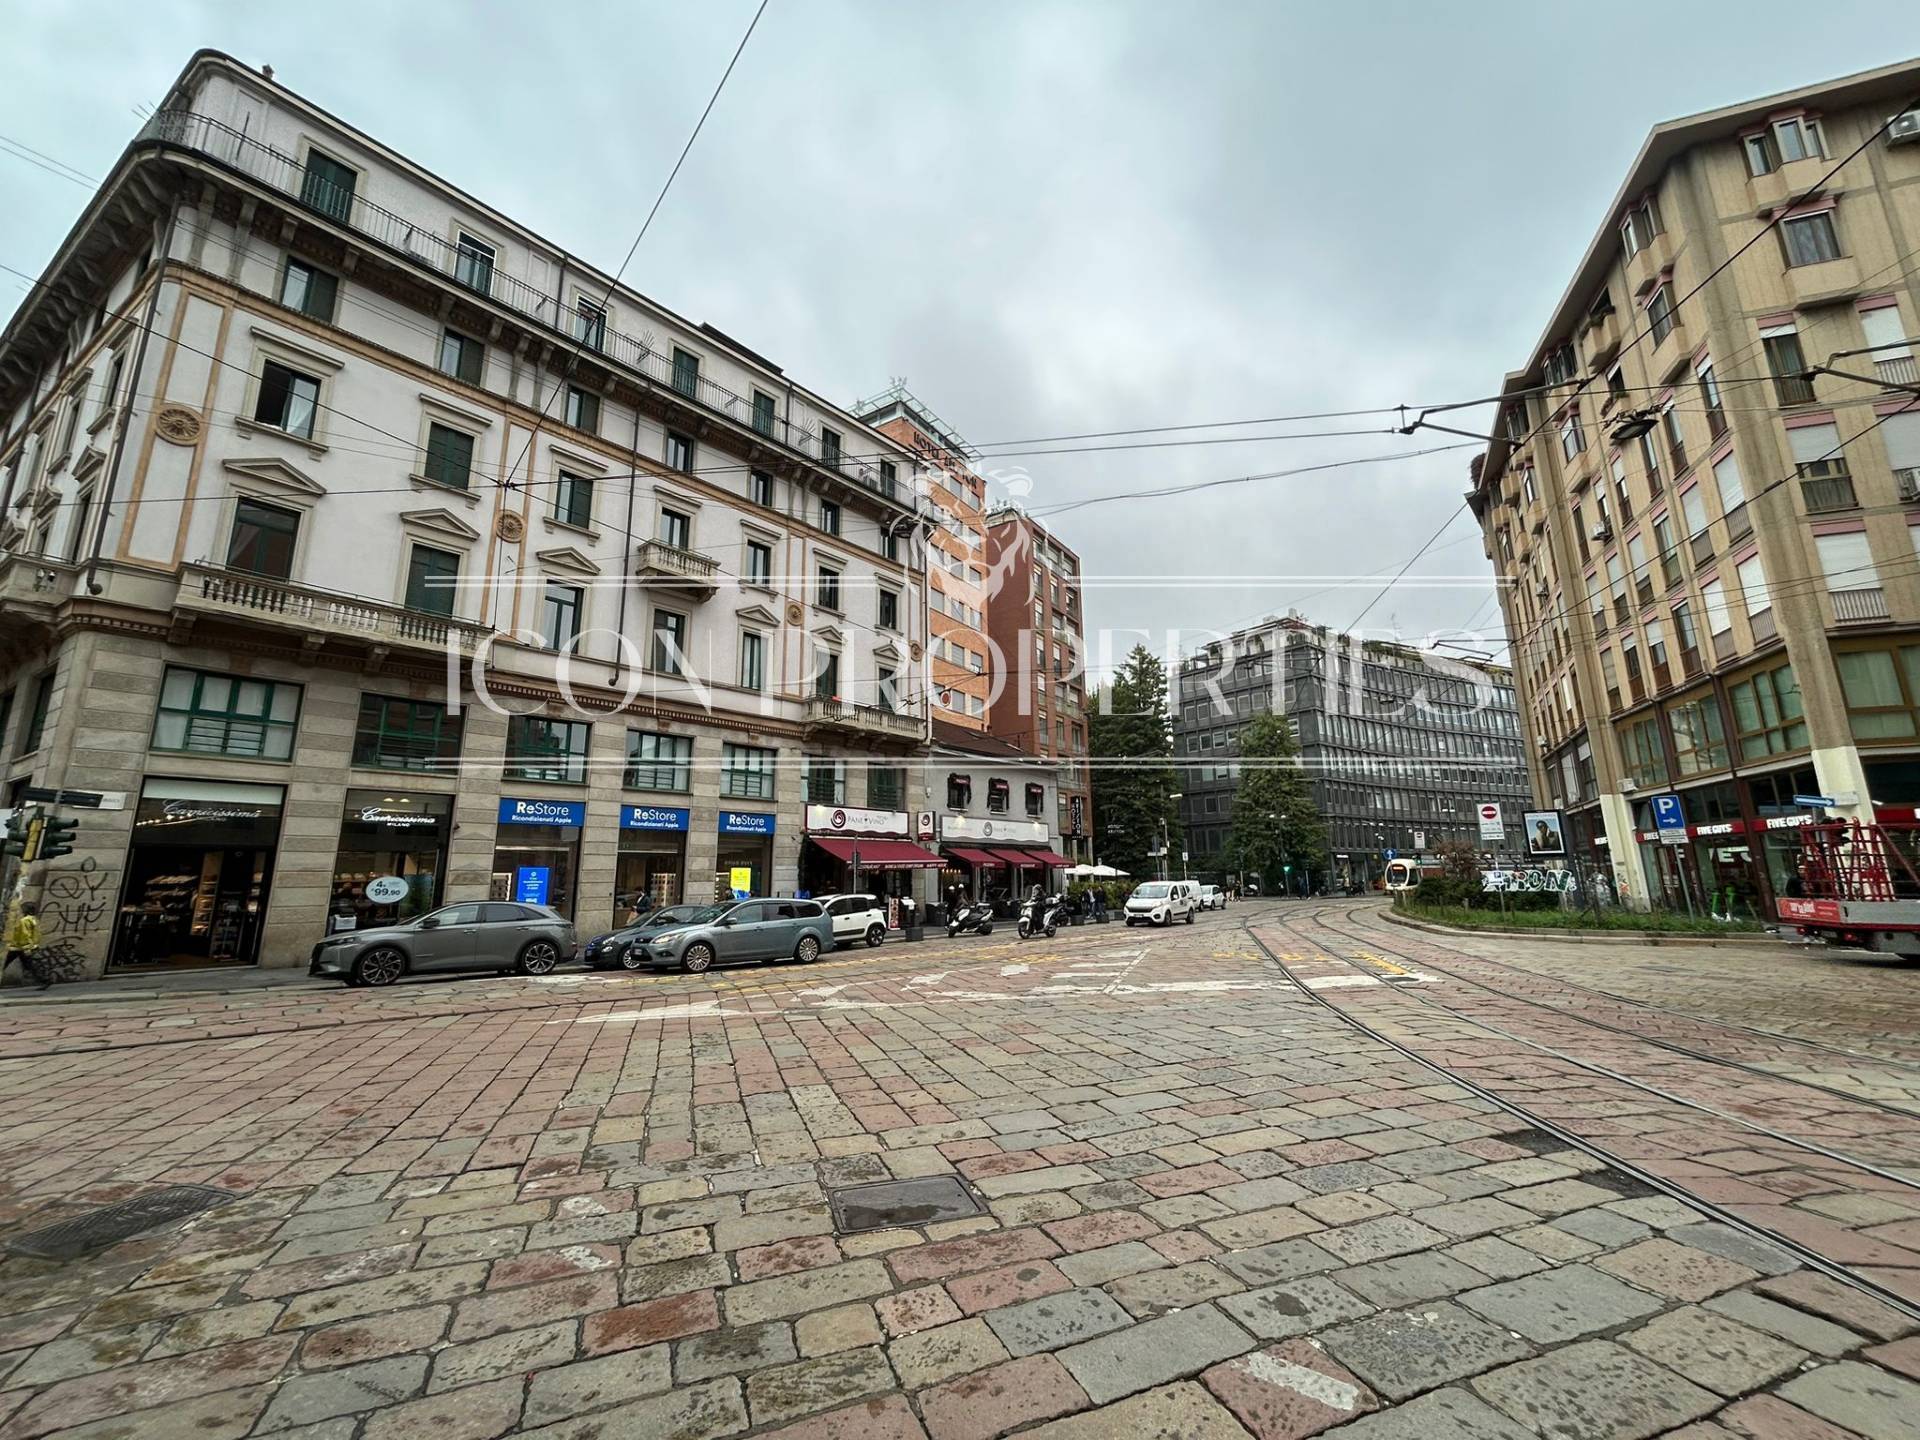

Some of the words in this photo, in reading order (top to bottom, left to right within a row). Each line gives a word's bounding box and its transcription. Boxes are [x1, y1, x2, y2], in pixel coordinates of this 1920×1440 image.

[913, 431, 940, 460] HOTEL
[516, 801, 569, 816] ReStore
[1657, 798, 1674, 815] P
[511, 814, 554, 824] Ricondizionati
[633, 808, 678, 822] ReStore
[729, 814, 765, 827] ReStore
[1766, 817, 1788, 829] FIVE
[1787, 814, 1813, 828] GUYS
